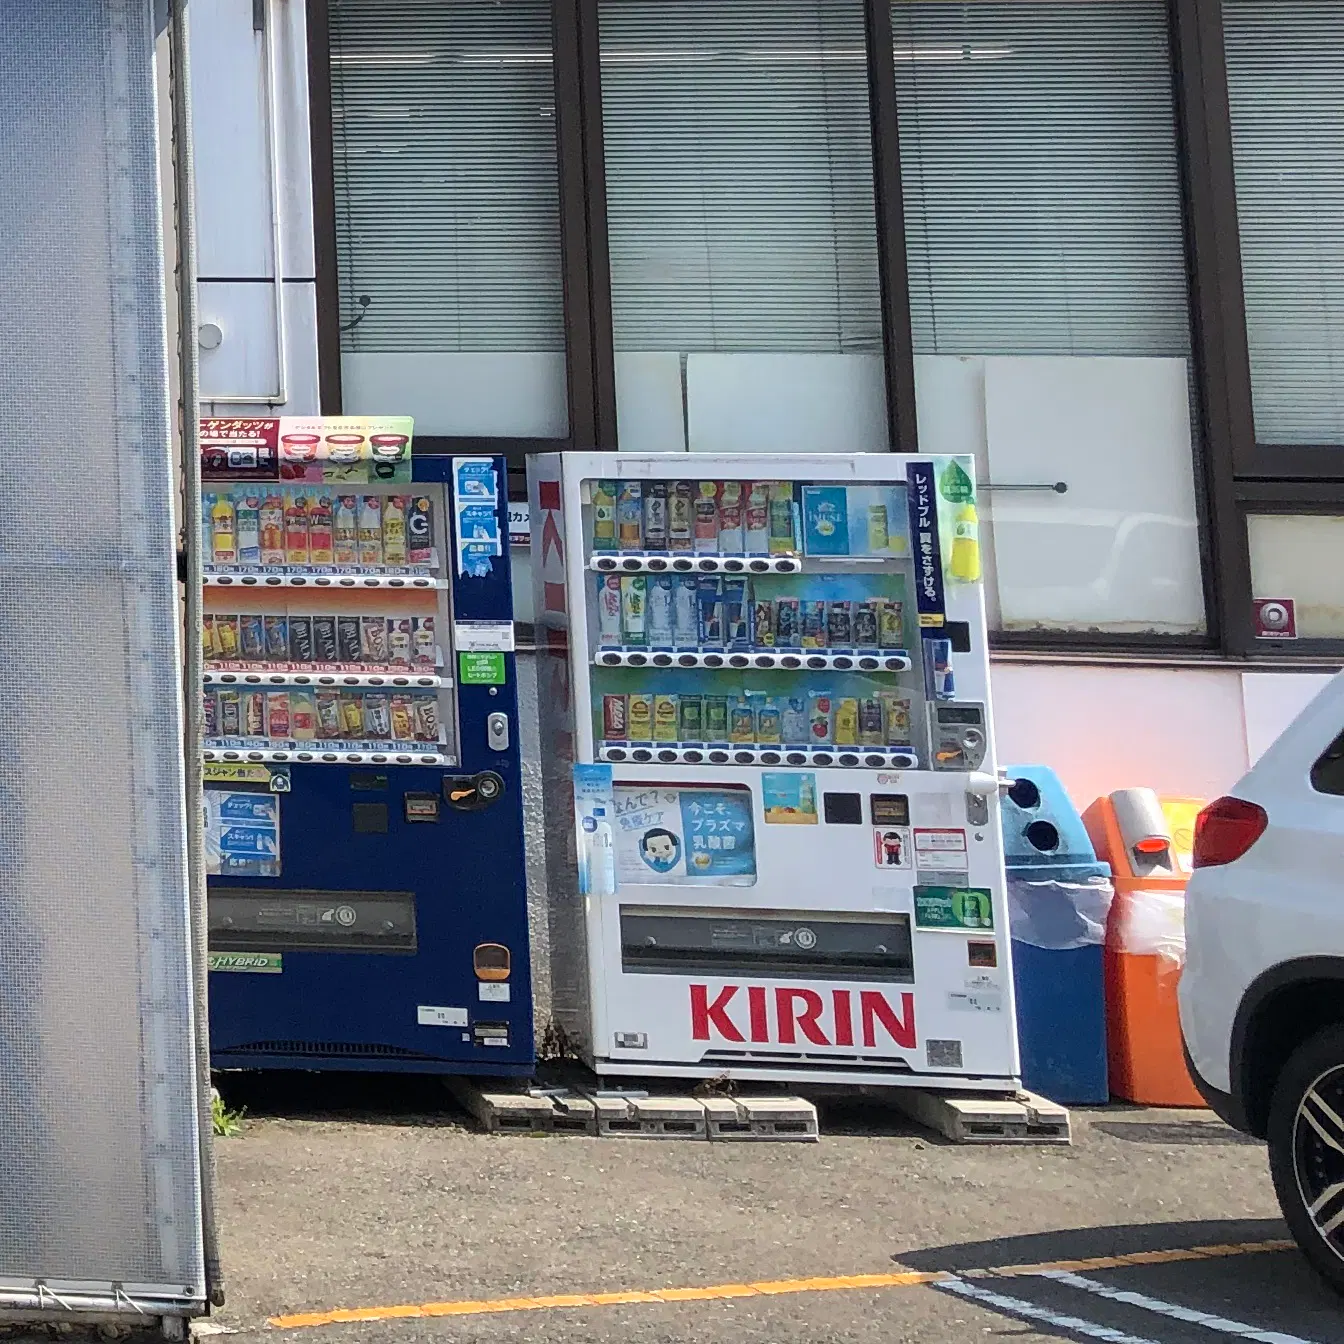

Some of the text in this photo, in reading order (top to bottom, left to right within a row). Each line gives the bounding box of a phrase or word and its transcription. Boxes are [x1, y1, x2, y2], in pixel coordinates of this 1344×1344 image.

[915, 473, 931, 528] レッドブル
[688, 801, 732, 816] 今こそ、
[691, 818, 746, 833] プラズマ
[692, 835, 737, 850] 乳酸菌
[689, 984, 917, 1049] KIRIN
